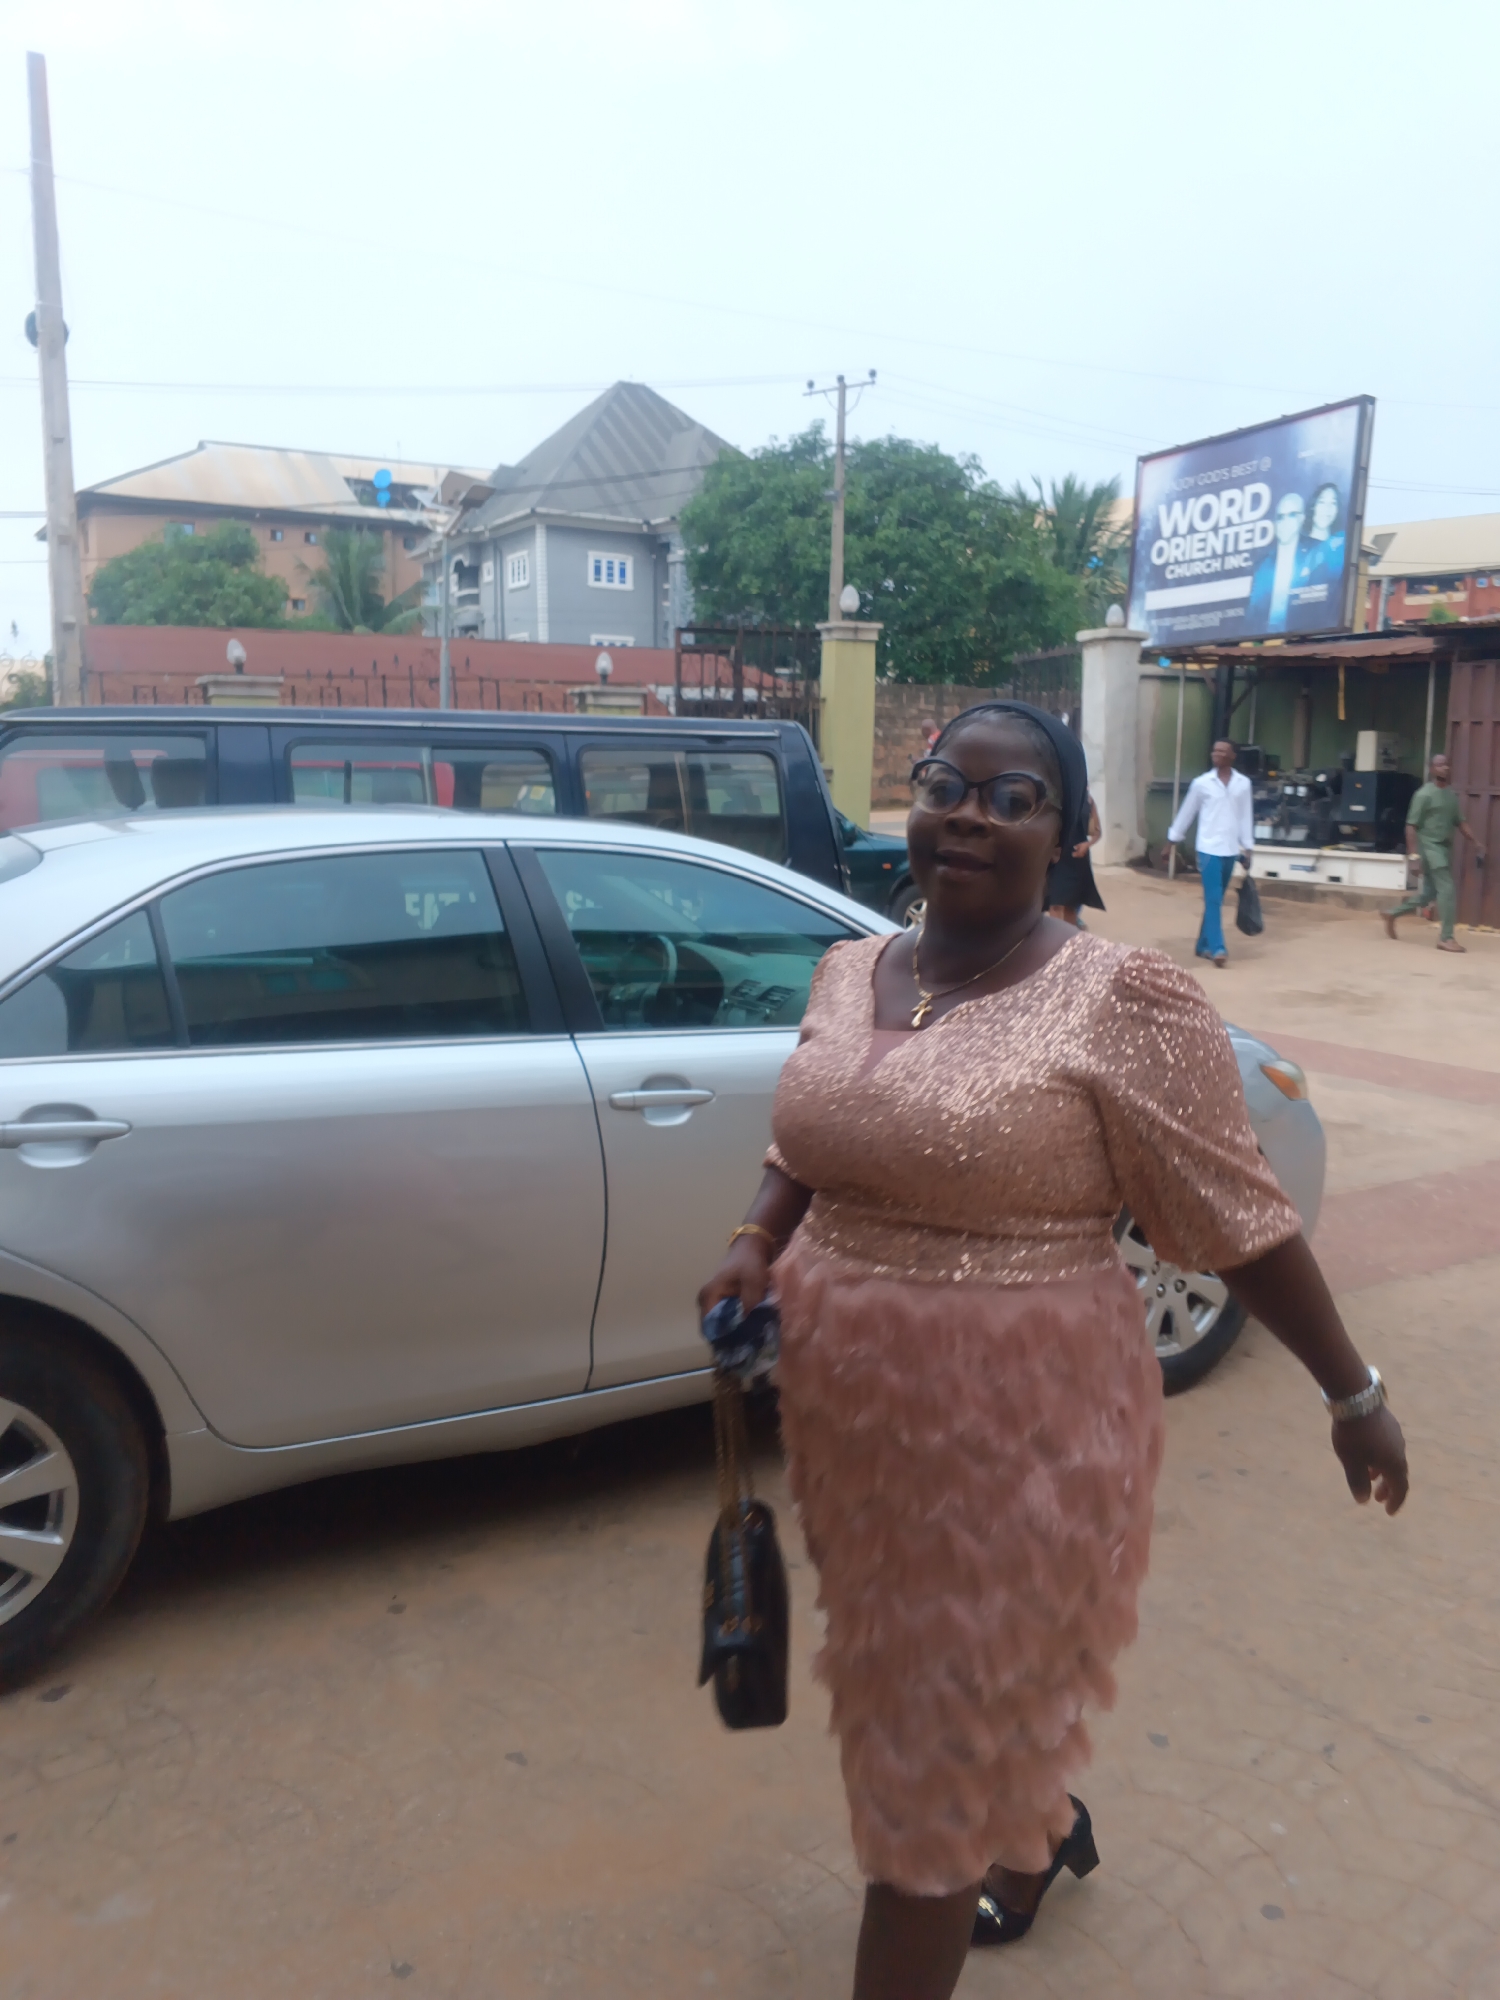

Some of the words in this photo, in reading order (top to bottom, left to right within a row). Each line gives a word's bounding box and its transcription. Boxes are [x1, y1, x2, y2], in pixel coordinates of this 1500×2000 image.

[1231, 460, 1258, 478] BEST
[1158, 482, 1272, 538] WORD
[1150, 520, 1275, 566] ORIENTED
[1165, 556, 1221, 580] CHURCH
[1224, 552, 1253, 571] INC.
